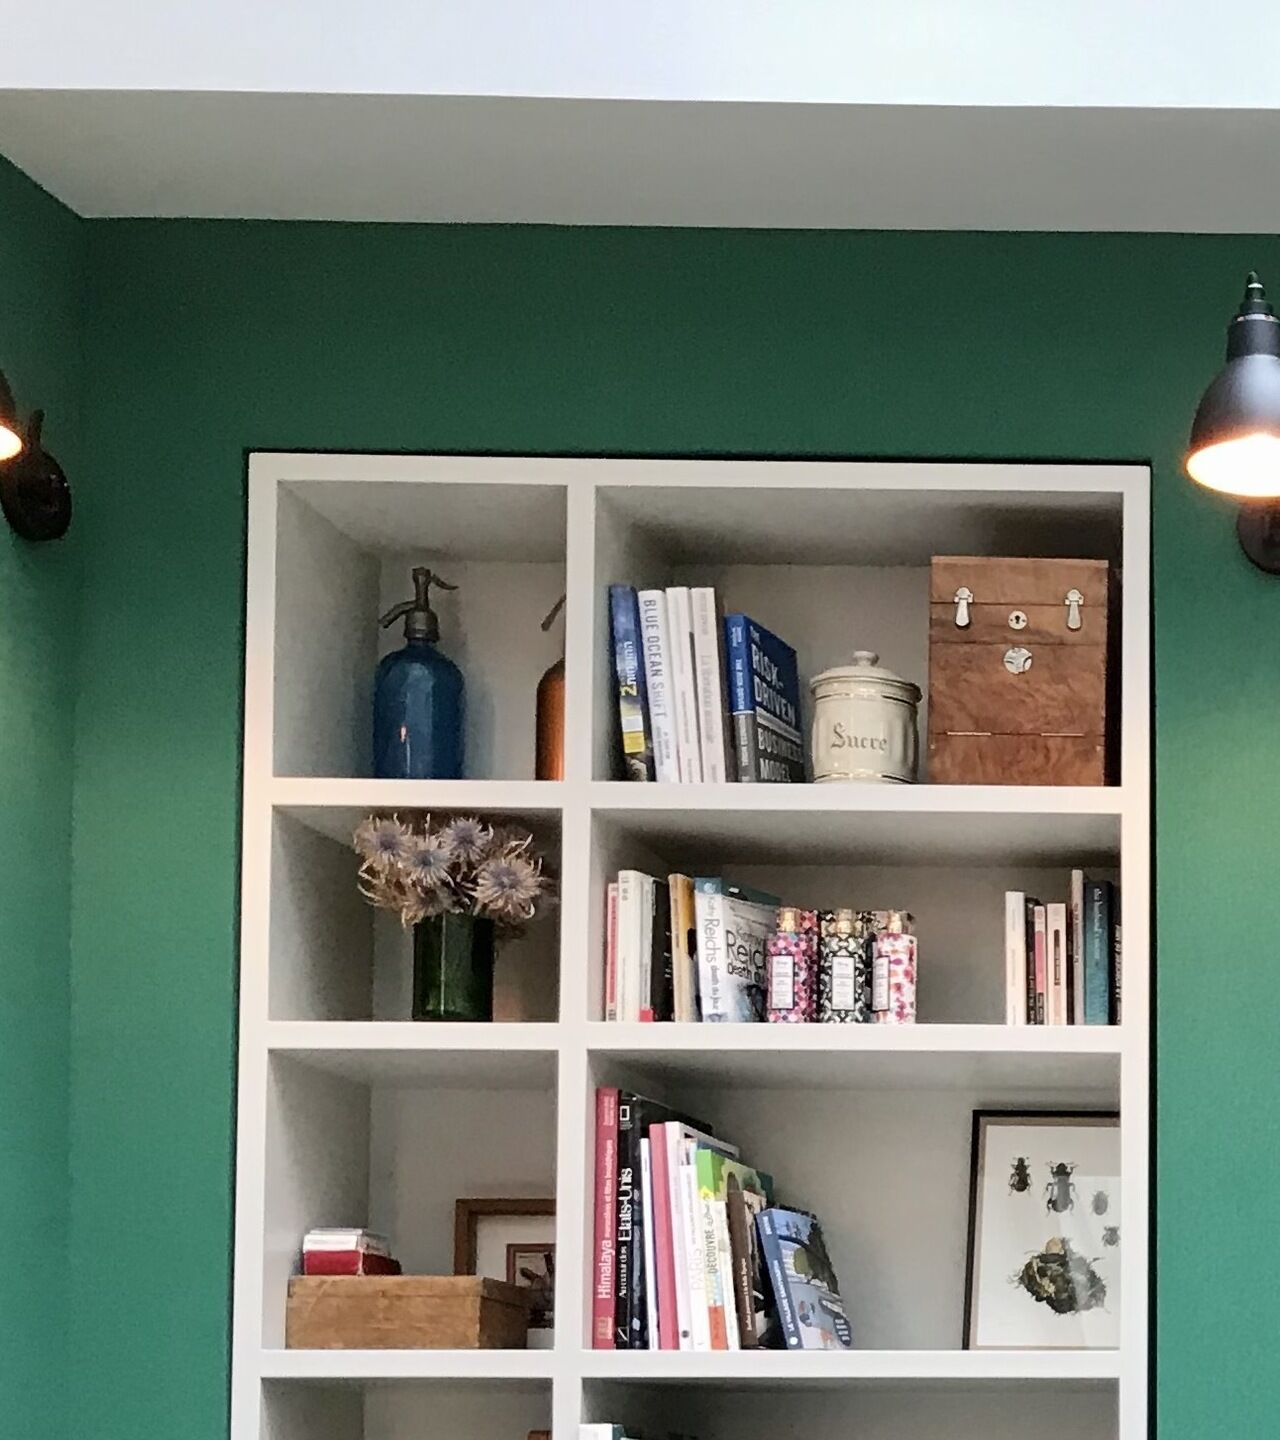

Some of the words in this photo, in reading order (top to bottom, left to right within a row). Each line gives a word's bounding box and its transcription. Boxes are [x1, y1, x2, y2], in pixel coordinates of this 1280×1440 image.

[643, 599, 658, 630] BLUE
[646, 636, 664, 677] OCEAN
[831, 722, 888, 752] Sucre
[703, 918, 722, 964] Reichs
[597, 1240, 615, 1298] Himalaya
